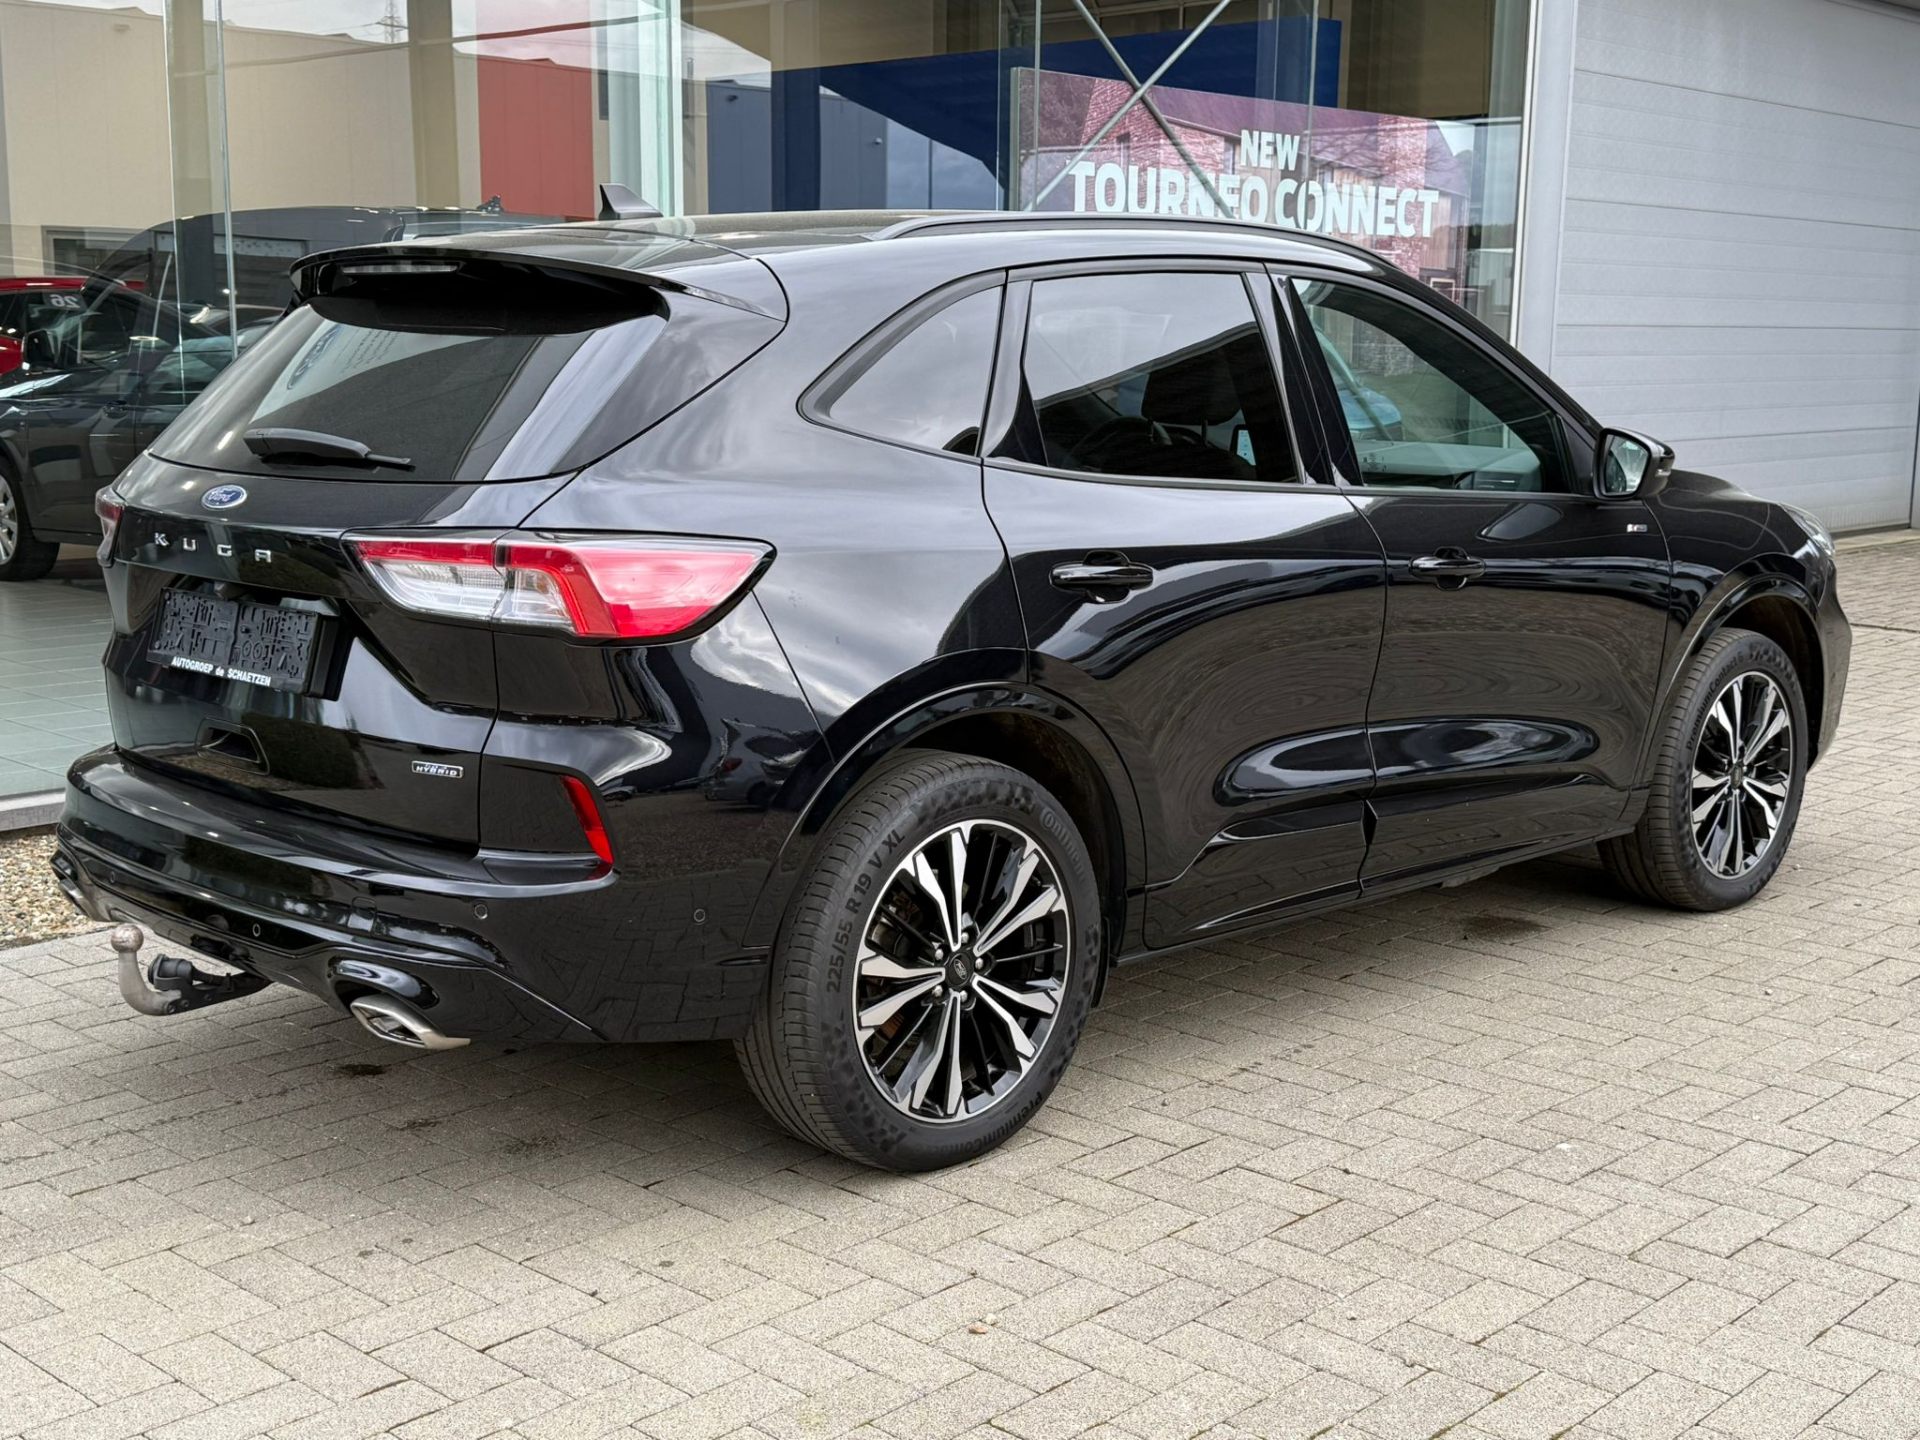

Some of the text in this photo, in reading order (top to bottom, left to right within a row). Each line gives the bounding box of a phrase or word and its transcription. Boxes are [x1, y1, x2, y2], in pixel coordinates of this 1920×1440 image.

[1240, 129, 1300, 171] NEW
[1067, 160, 1440, 238] TOURNEO CONNECT
[154, 532, 272, 563] KUGA
[171, 655, 272, 687] AUTOGROEP de SCHAETZEN
[826, 829, 906, 994] 225/55 R 19 V XL
